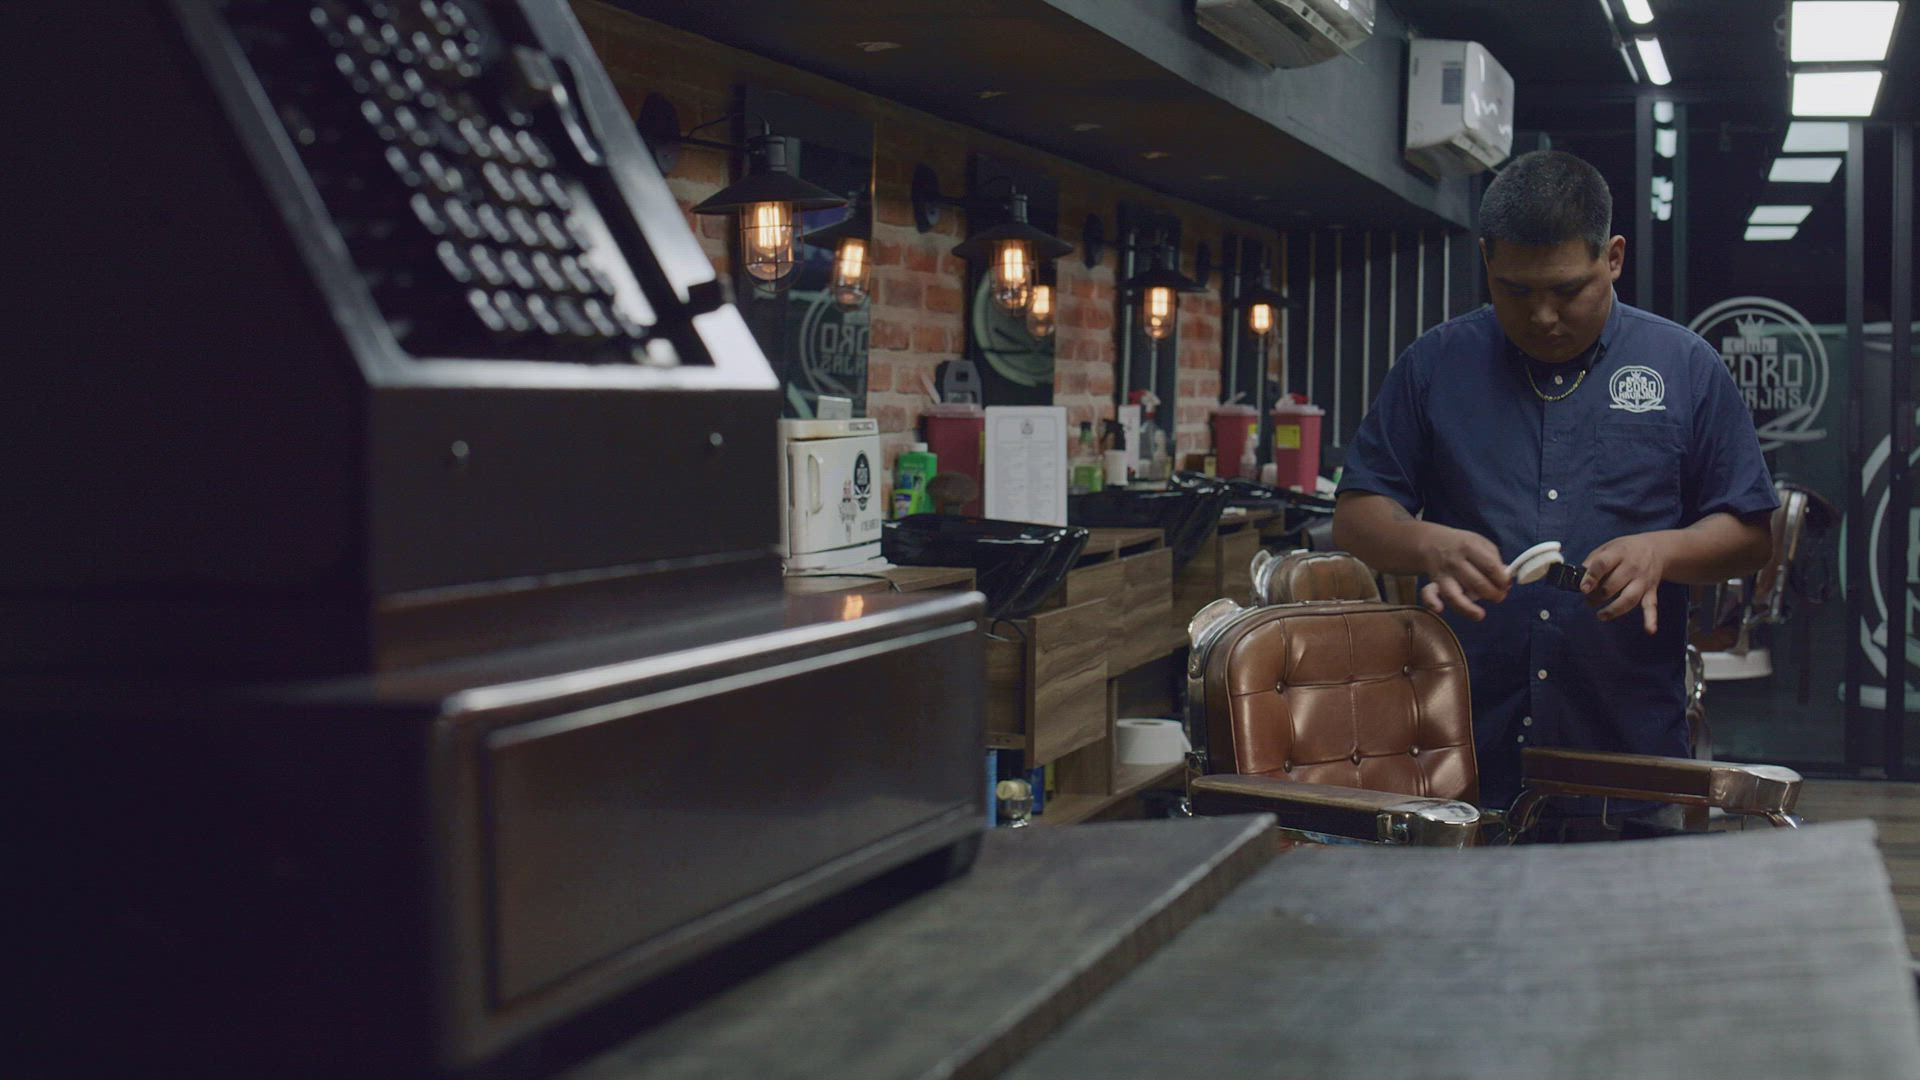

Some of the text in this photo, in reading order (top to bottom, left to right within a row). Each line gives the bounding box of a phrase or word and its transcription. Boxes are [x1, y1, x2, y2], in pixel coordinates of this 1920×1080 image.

[1720, 354, 1803, 387] DRO
[1618, 380, 1656, 392] PEDRO
[1739, 387, 1802, 409] AJAS
